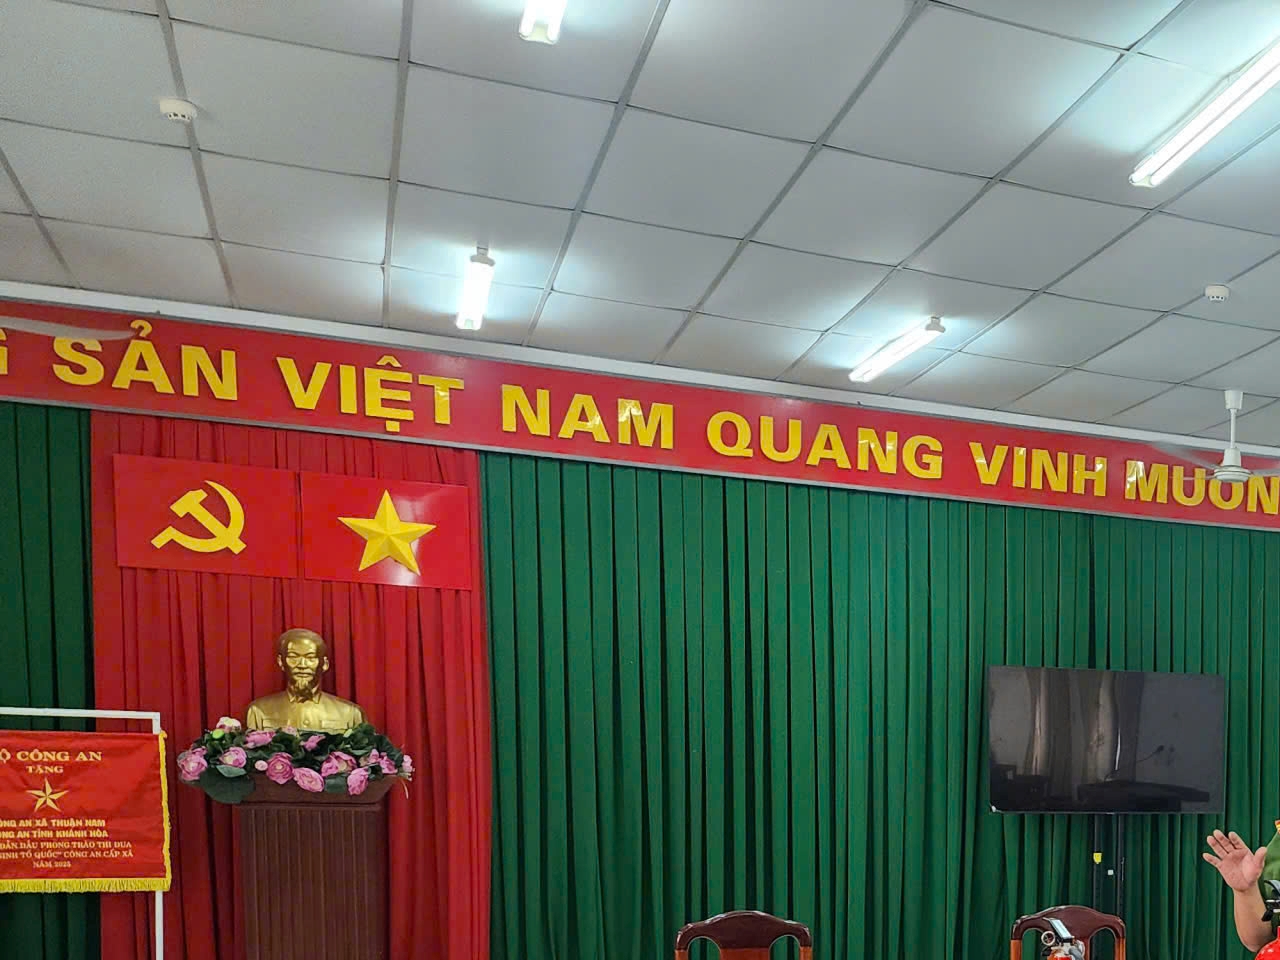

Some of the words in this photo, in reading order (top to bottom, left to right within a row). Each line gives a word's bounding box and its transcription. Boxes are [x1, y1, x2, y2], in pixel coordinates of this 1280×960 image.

[52, 319, 238, 400] SẢN
[276, 355, 465, 432] VIỆT
[501, 384, 675, 450] NAM
[705, 410, 943, 479] QUANG
[968, 443, 1107, 498] VINH
[0, 748, 11, 764] Ộ
[16, 749, 70, 761] CÔNG
[75, 751, 102, 761] AN
[26, 764, 64, 774] TẶNG
[19, 819, 32, 827] AN
[35, 818, 48, 827] XÃ
[51, 818, 83, 828] THUẬN
[85, 819, 106, 827] NAM
[0, 831, 15, 839] NG
[17, 831, 30, 839] AN
[32, 828, 54, 839] TỈNH
[56, 829, 87, 838] KHÁNH
[90, 828, 109, 838] HÒA
[97, 841, 112, 849] THI
[64, 850, 88, 858] CÔNG
[122, 848, 133, 858] XÃ
